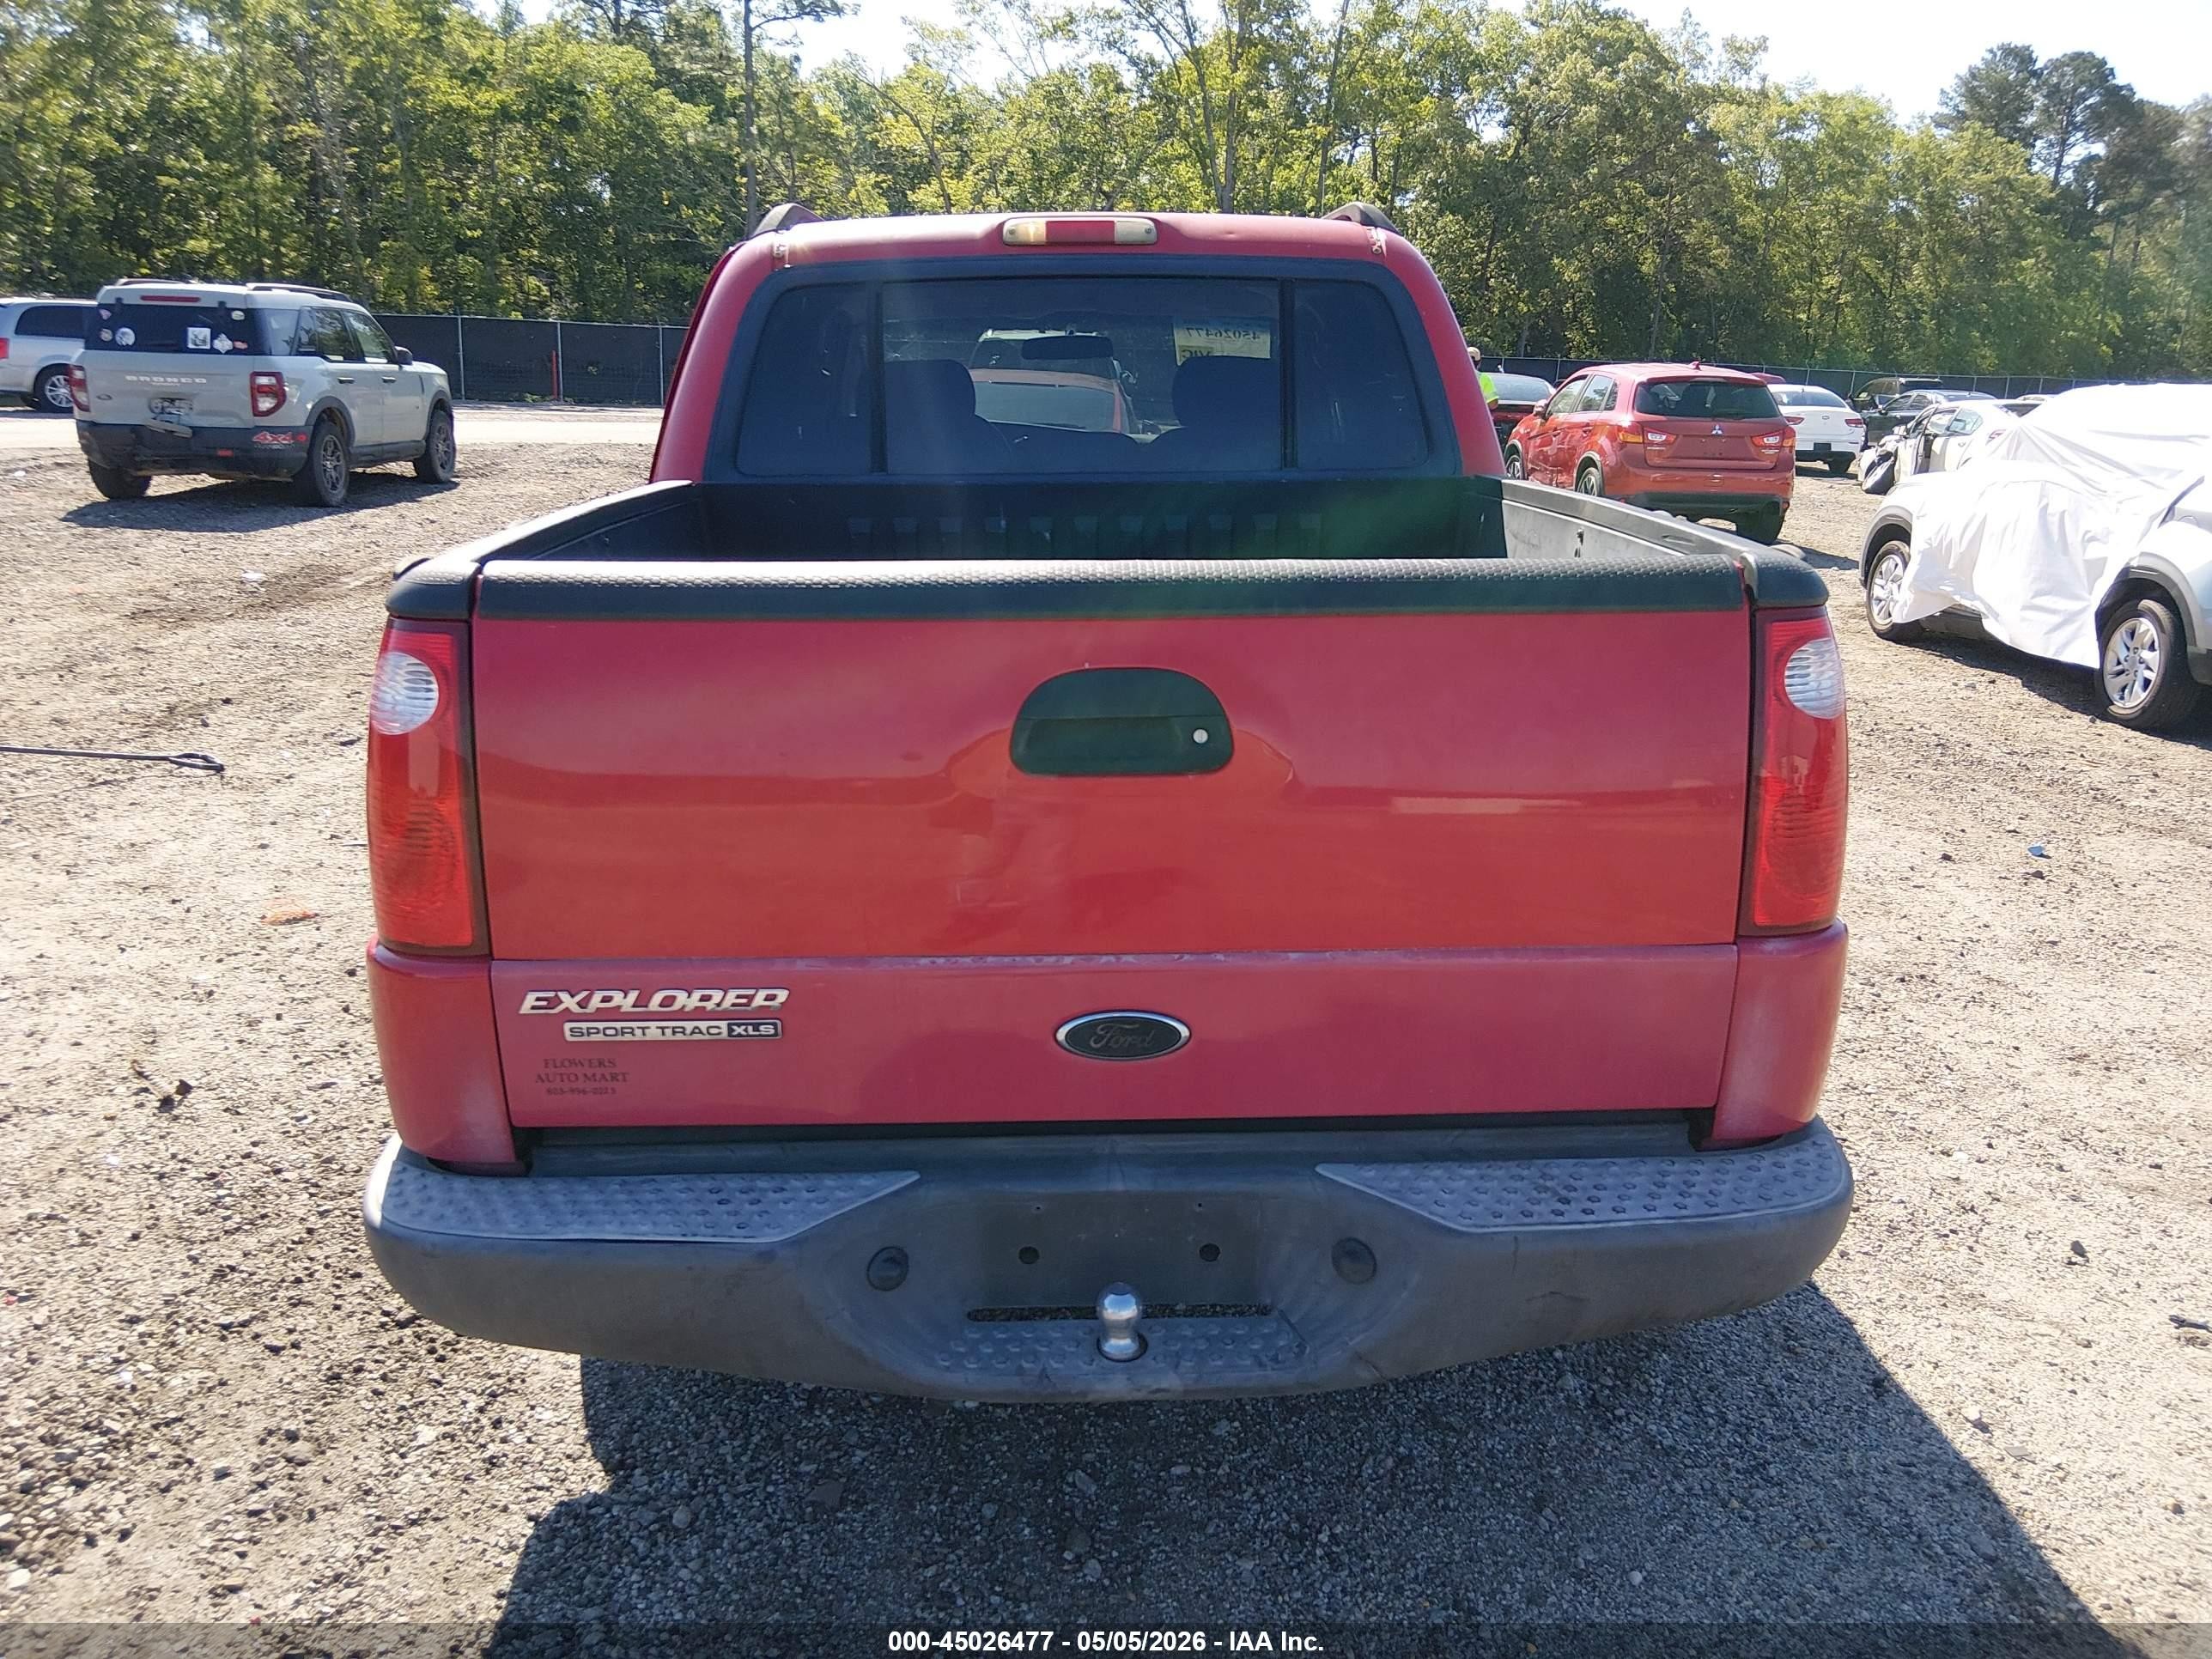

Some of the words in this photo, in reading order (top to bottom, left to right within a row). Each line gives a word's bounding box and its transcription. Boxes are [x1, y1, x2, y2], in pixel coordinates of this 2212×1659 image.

[125, 375, 207, 384] BRONCO
[519, 988, 789, 1014] EXPLORER
[569, 1026, 651, 1037] SPORT
[655, 1025, 722, 1036] TRAC
[731, 1024, 775, 1036] XLS
[1090, 1023, 1154, 1048] Ford
[543, 1058, 617, 1069] FLOWERS
[535, 1073, 580, 1084] AUTO
[582, 1072, 630, 1083] MART
